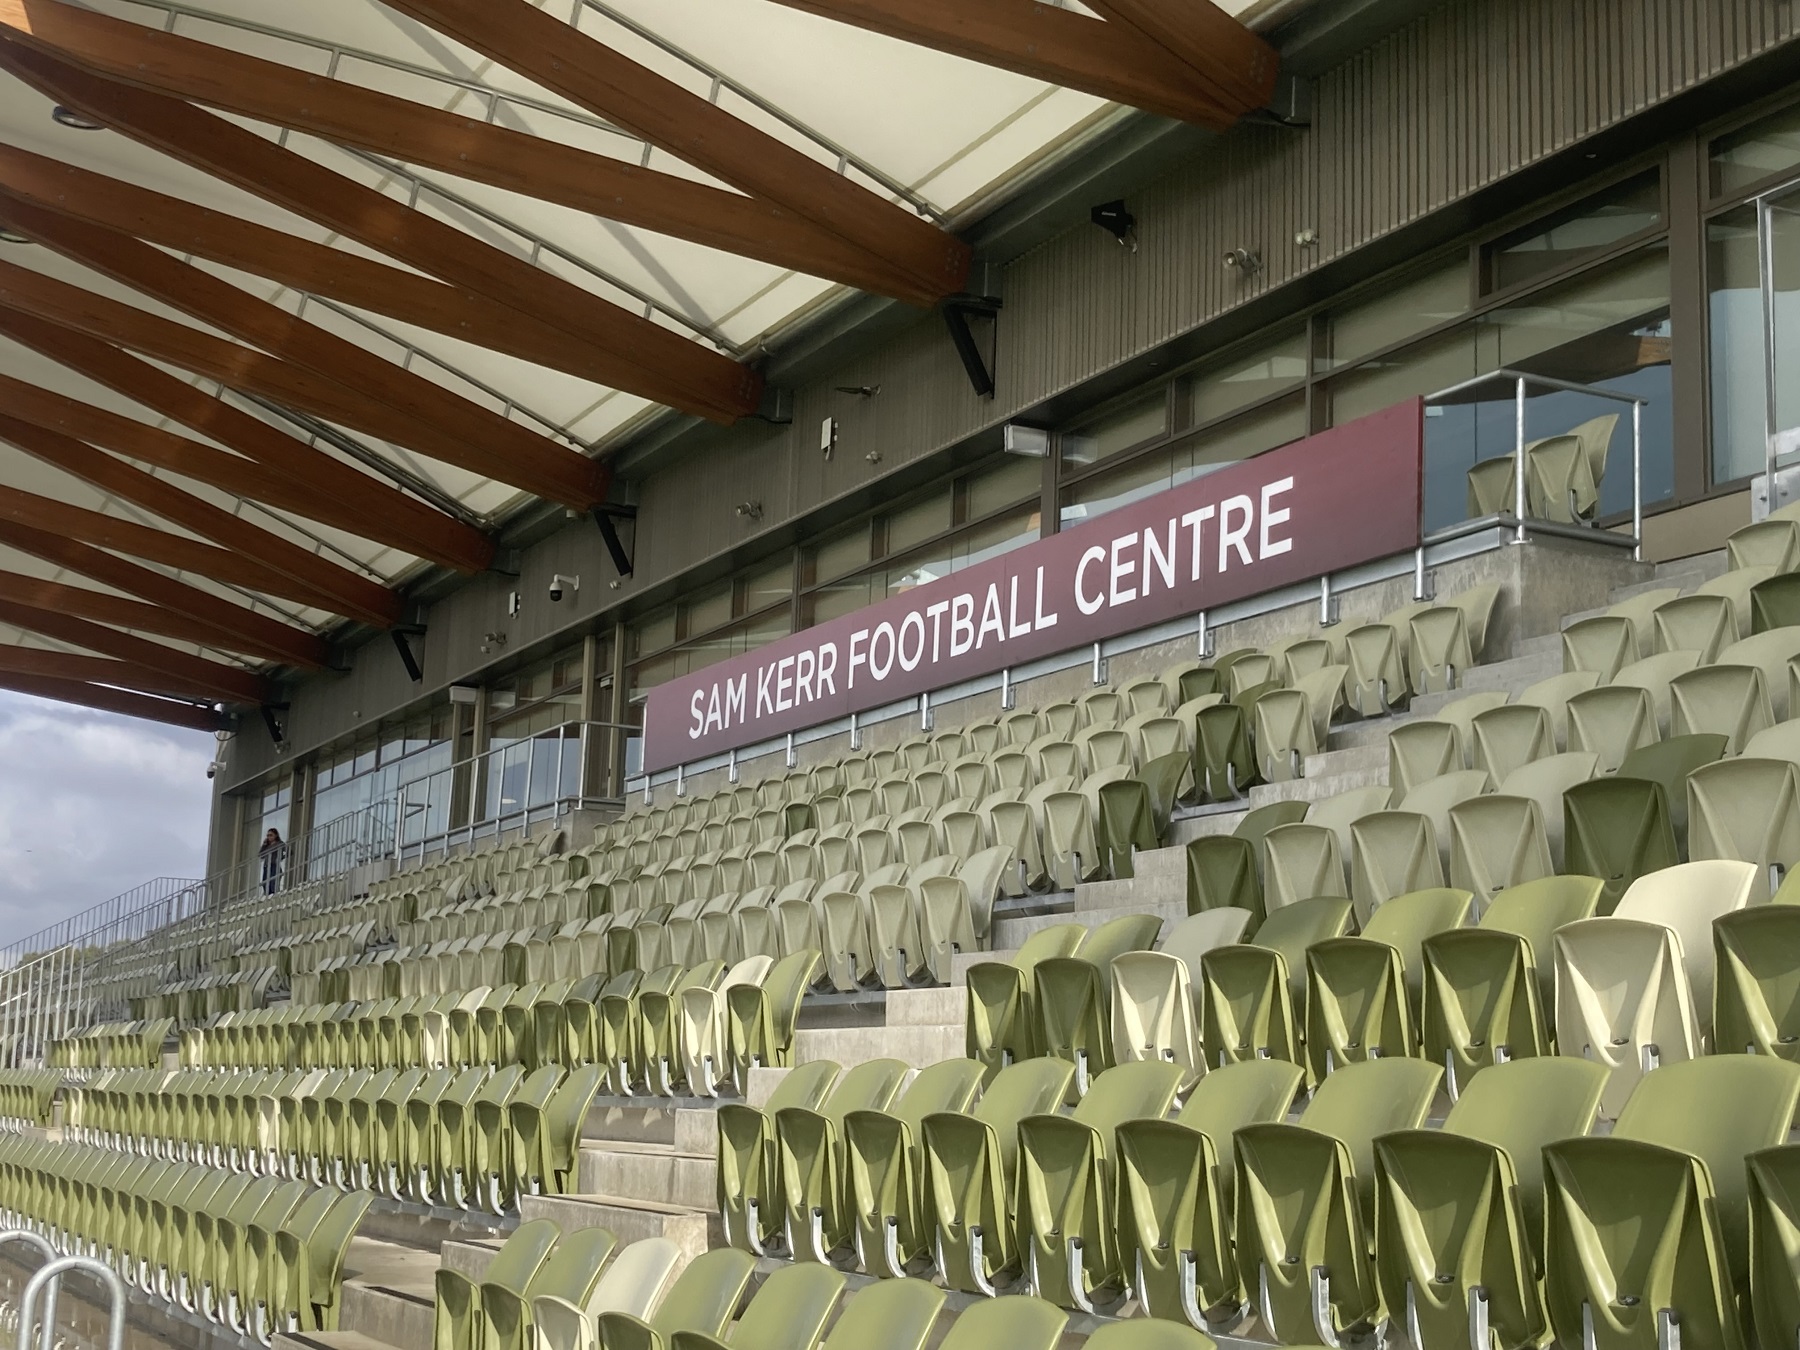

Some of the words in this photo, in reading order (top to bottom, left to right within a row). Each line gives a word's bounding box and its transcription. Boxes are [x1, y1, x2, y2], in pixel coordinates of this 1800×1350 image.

[689, 673, 747, 740] SAM
[755, 642, 838, 719] KERR
[848, 565, 1058, 690] FOOTBALL
[1074, 475, 1294, 616] CENTRE
